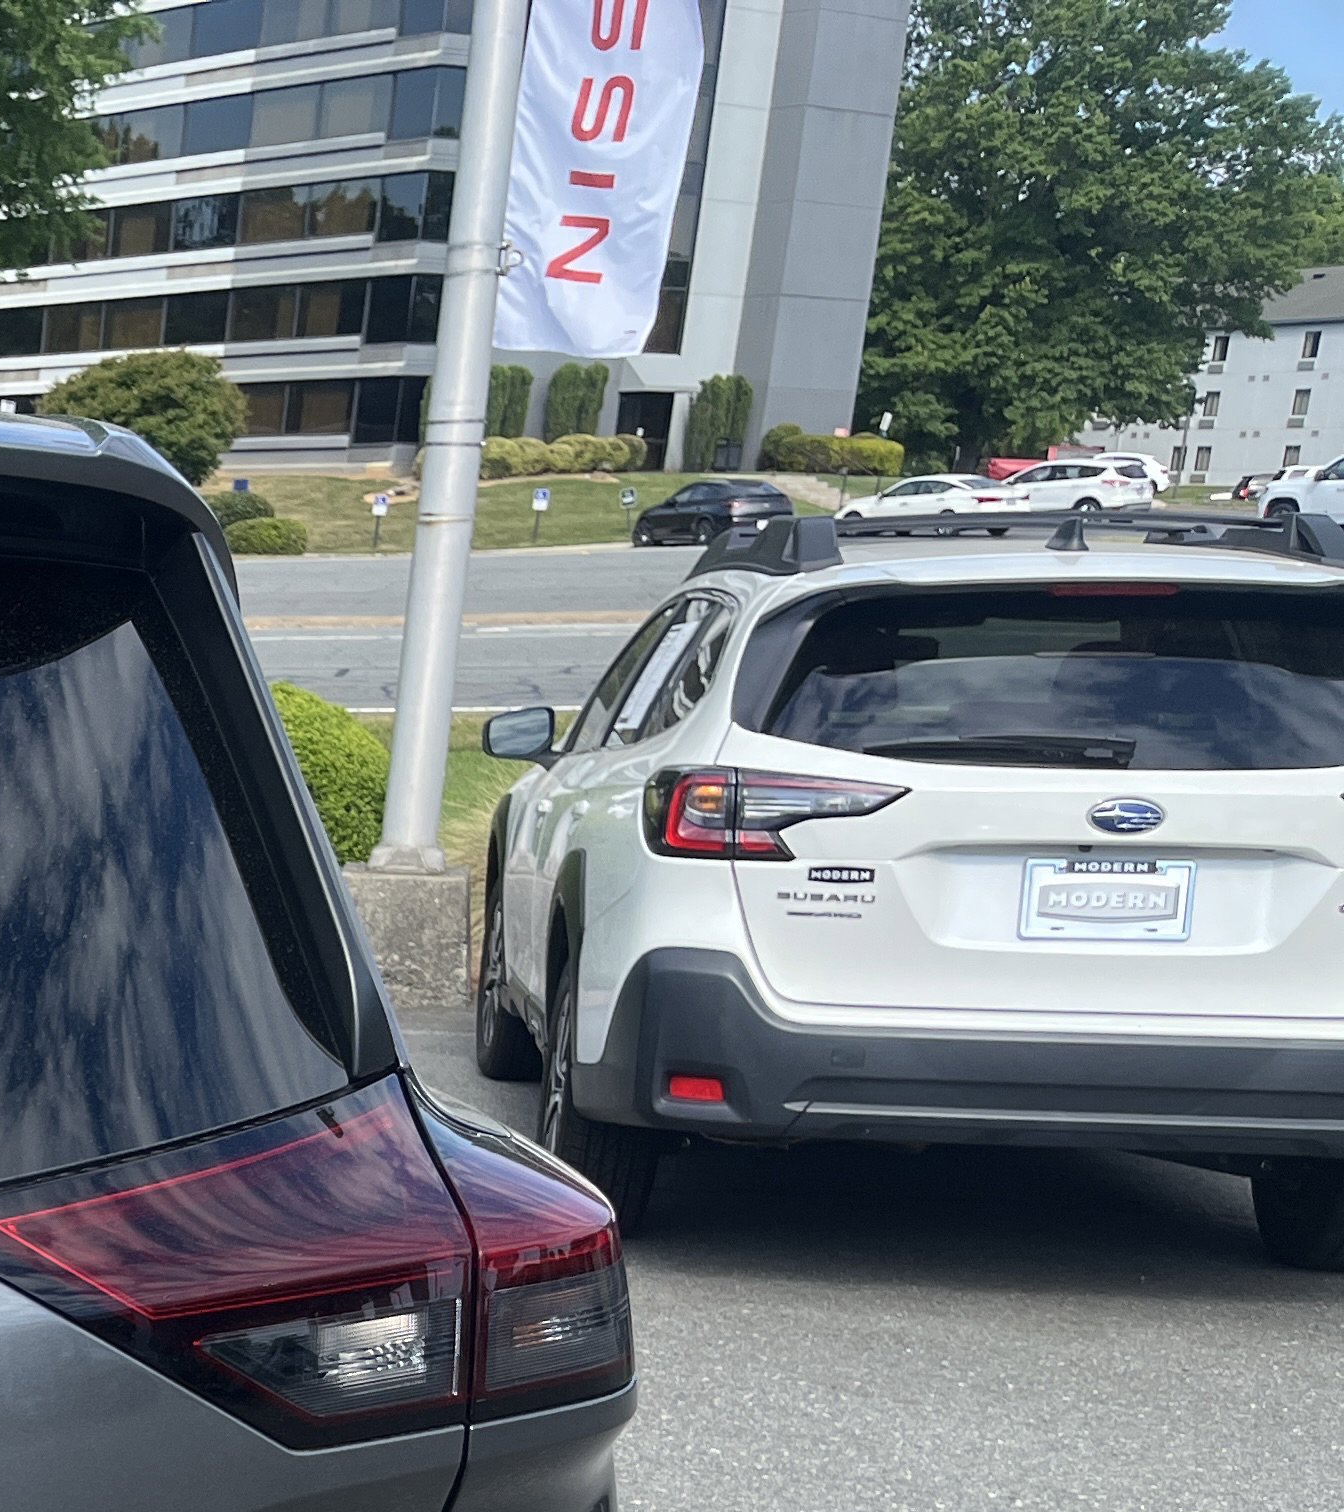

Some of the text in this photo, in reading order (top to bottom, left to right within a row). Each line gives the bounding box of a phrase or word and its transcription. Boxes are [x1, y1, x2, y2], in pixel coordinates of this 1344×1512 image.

[1074, 861, 1149, 873] MODERN
[811, 869, 871, 880] MODERN
[777, 892, 875, 903] SUBARU
[1048, 891, 1167, 910] MODERN
